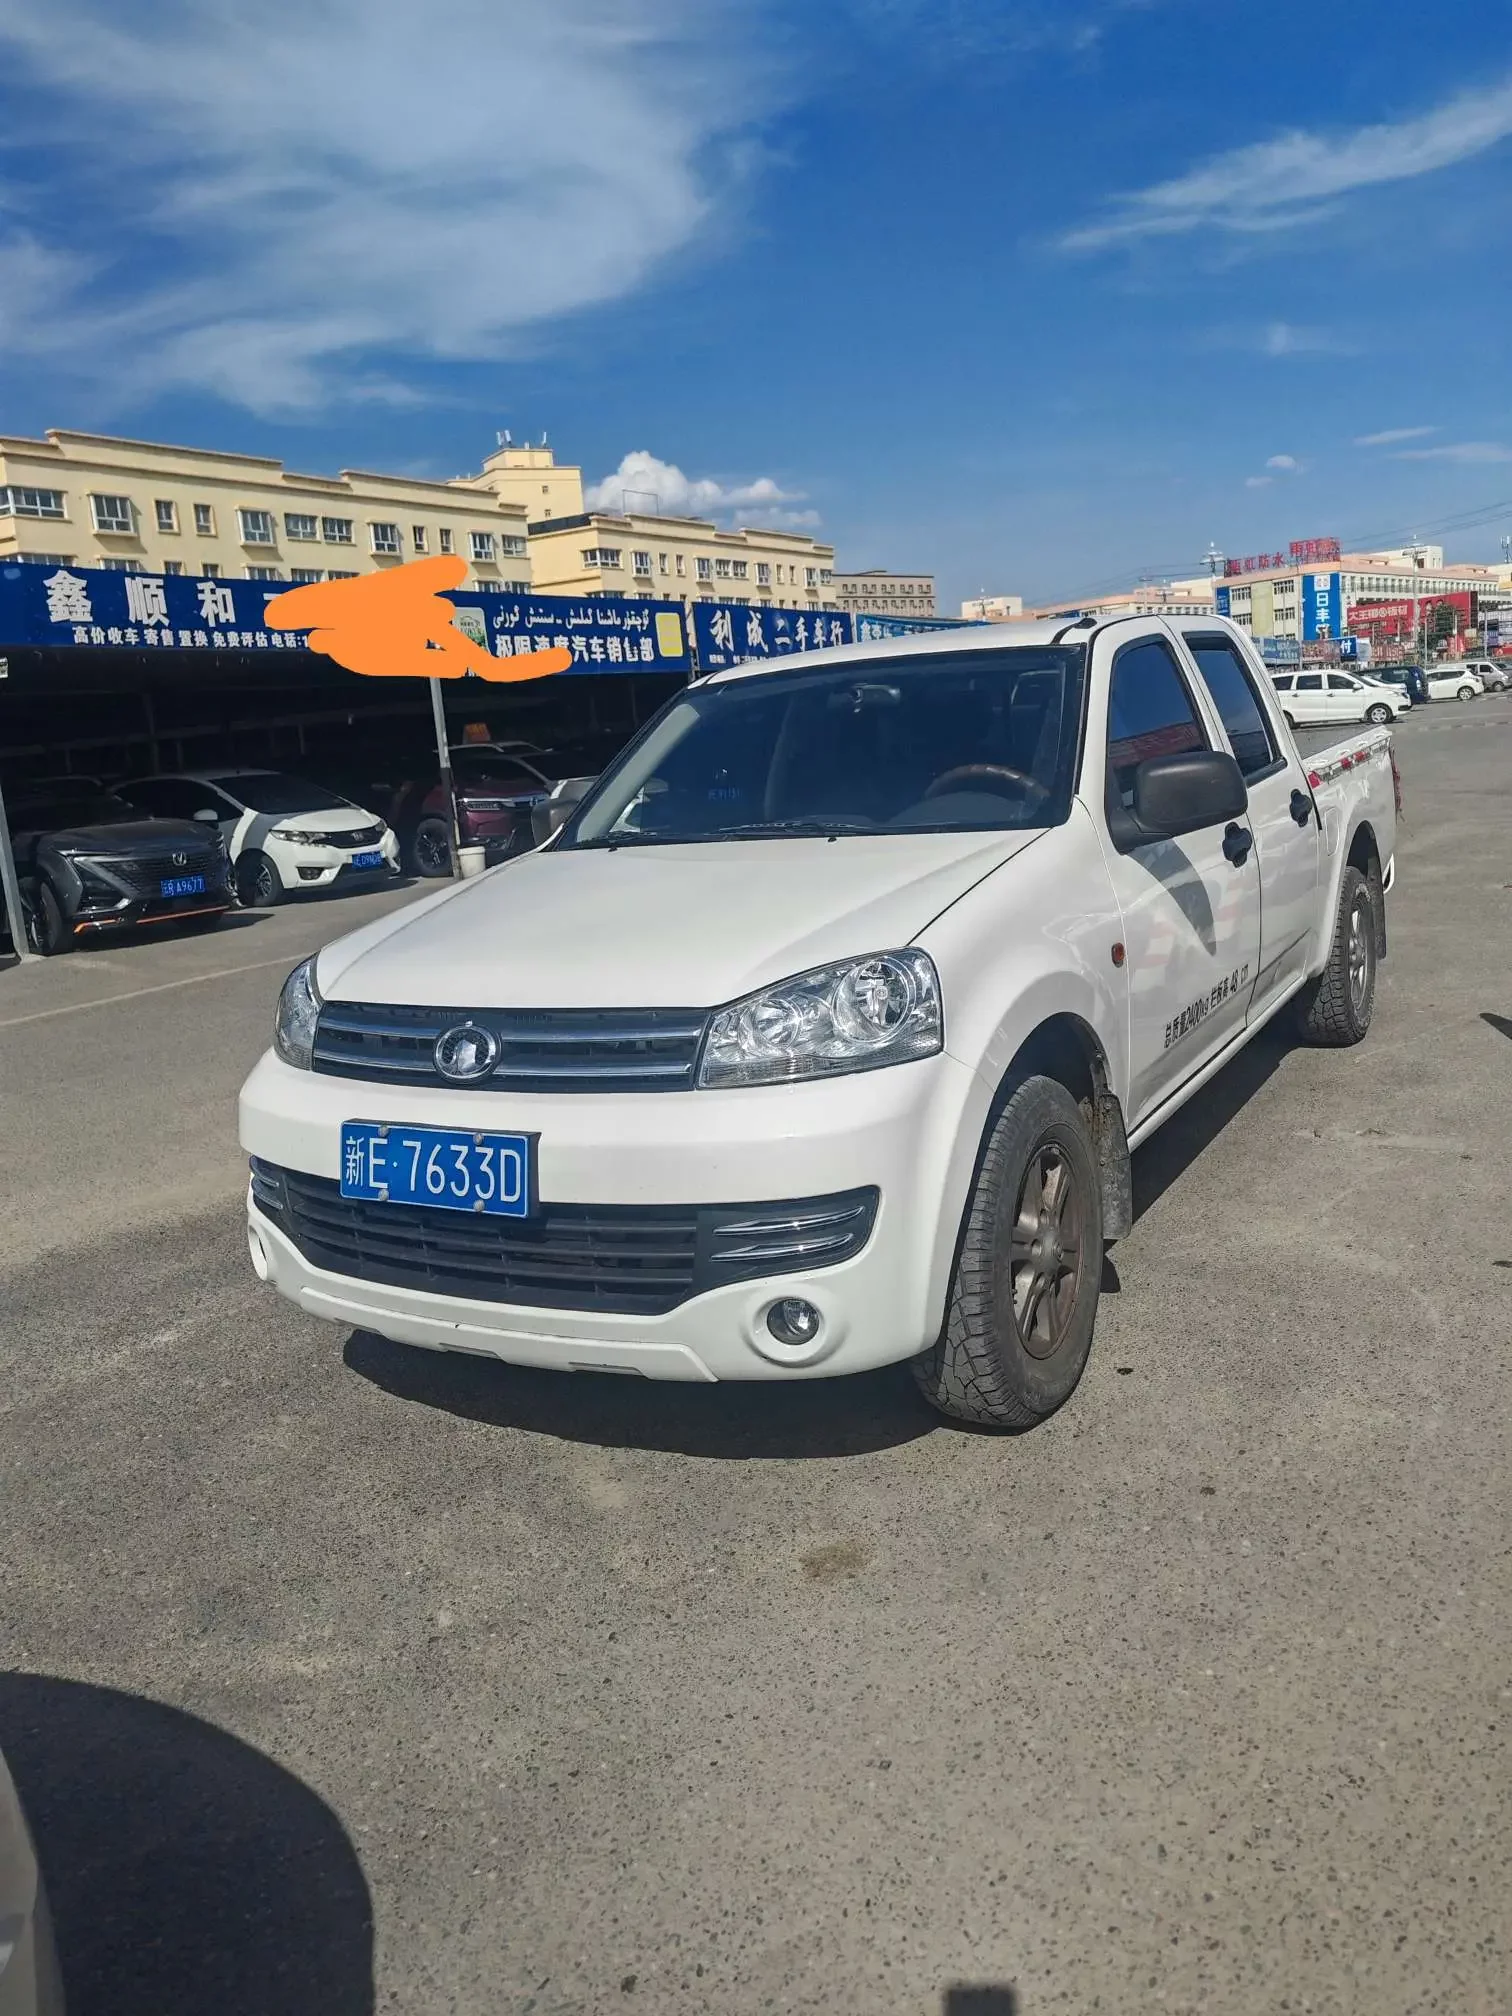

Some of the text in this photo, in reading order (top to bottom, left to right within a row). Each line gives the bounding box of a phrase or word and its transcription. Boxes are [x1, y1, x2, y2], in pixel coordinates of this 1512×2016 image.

[43, 570, 282, 627] 鑫顺和
[345, 1136, 522, 1203] 新E·7633D
